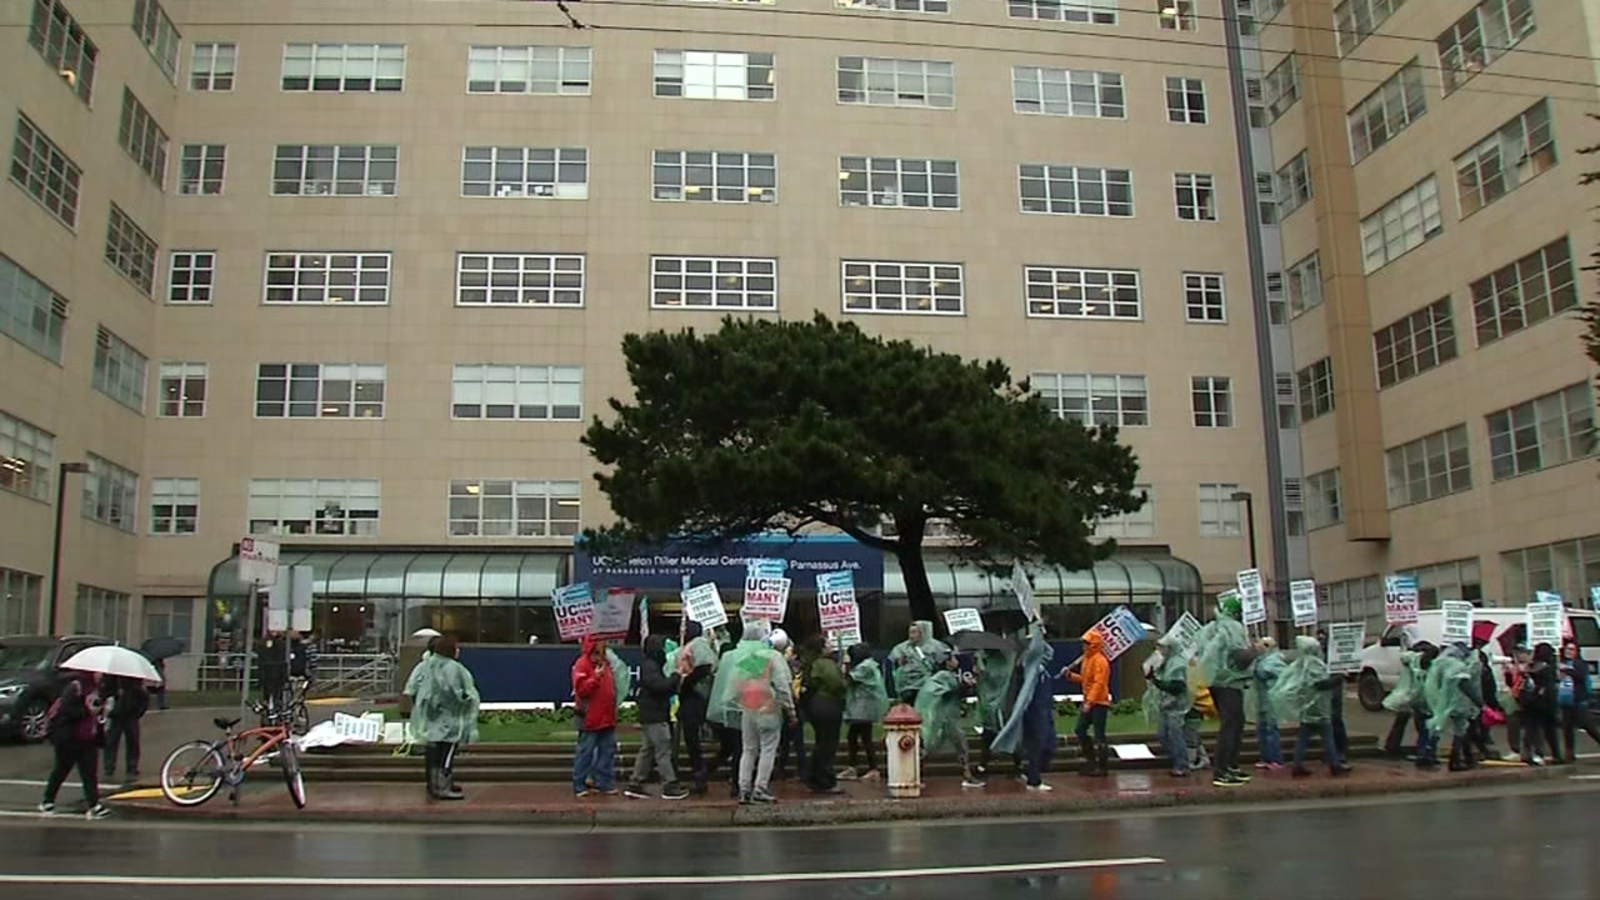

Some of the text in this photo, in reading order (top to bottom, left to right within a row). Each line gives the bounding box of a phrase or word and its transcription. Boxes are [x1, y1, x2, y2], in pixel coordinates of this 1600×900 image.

[680, 556, 719, 566] Medical
[790, 559, 839, 570] Parnassus
[840, 560, 862, 570] Ave.
[748, 579, 767, 591] UC
[747, 592, 780, 602] MANY
[820, 592, 840, 606] UC
[1386, 593, 1404, 604] UC
[555, 604, 578, 619] UC
[821, 604, 854, 615] MANY
[1387, 604, 1415, 612] MANY
[559, 613, 593, 627] MANY
[1103, 616, 1122, 638] UC
[1095, 622, 1121, 652] MANY
